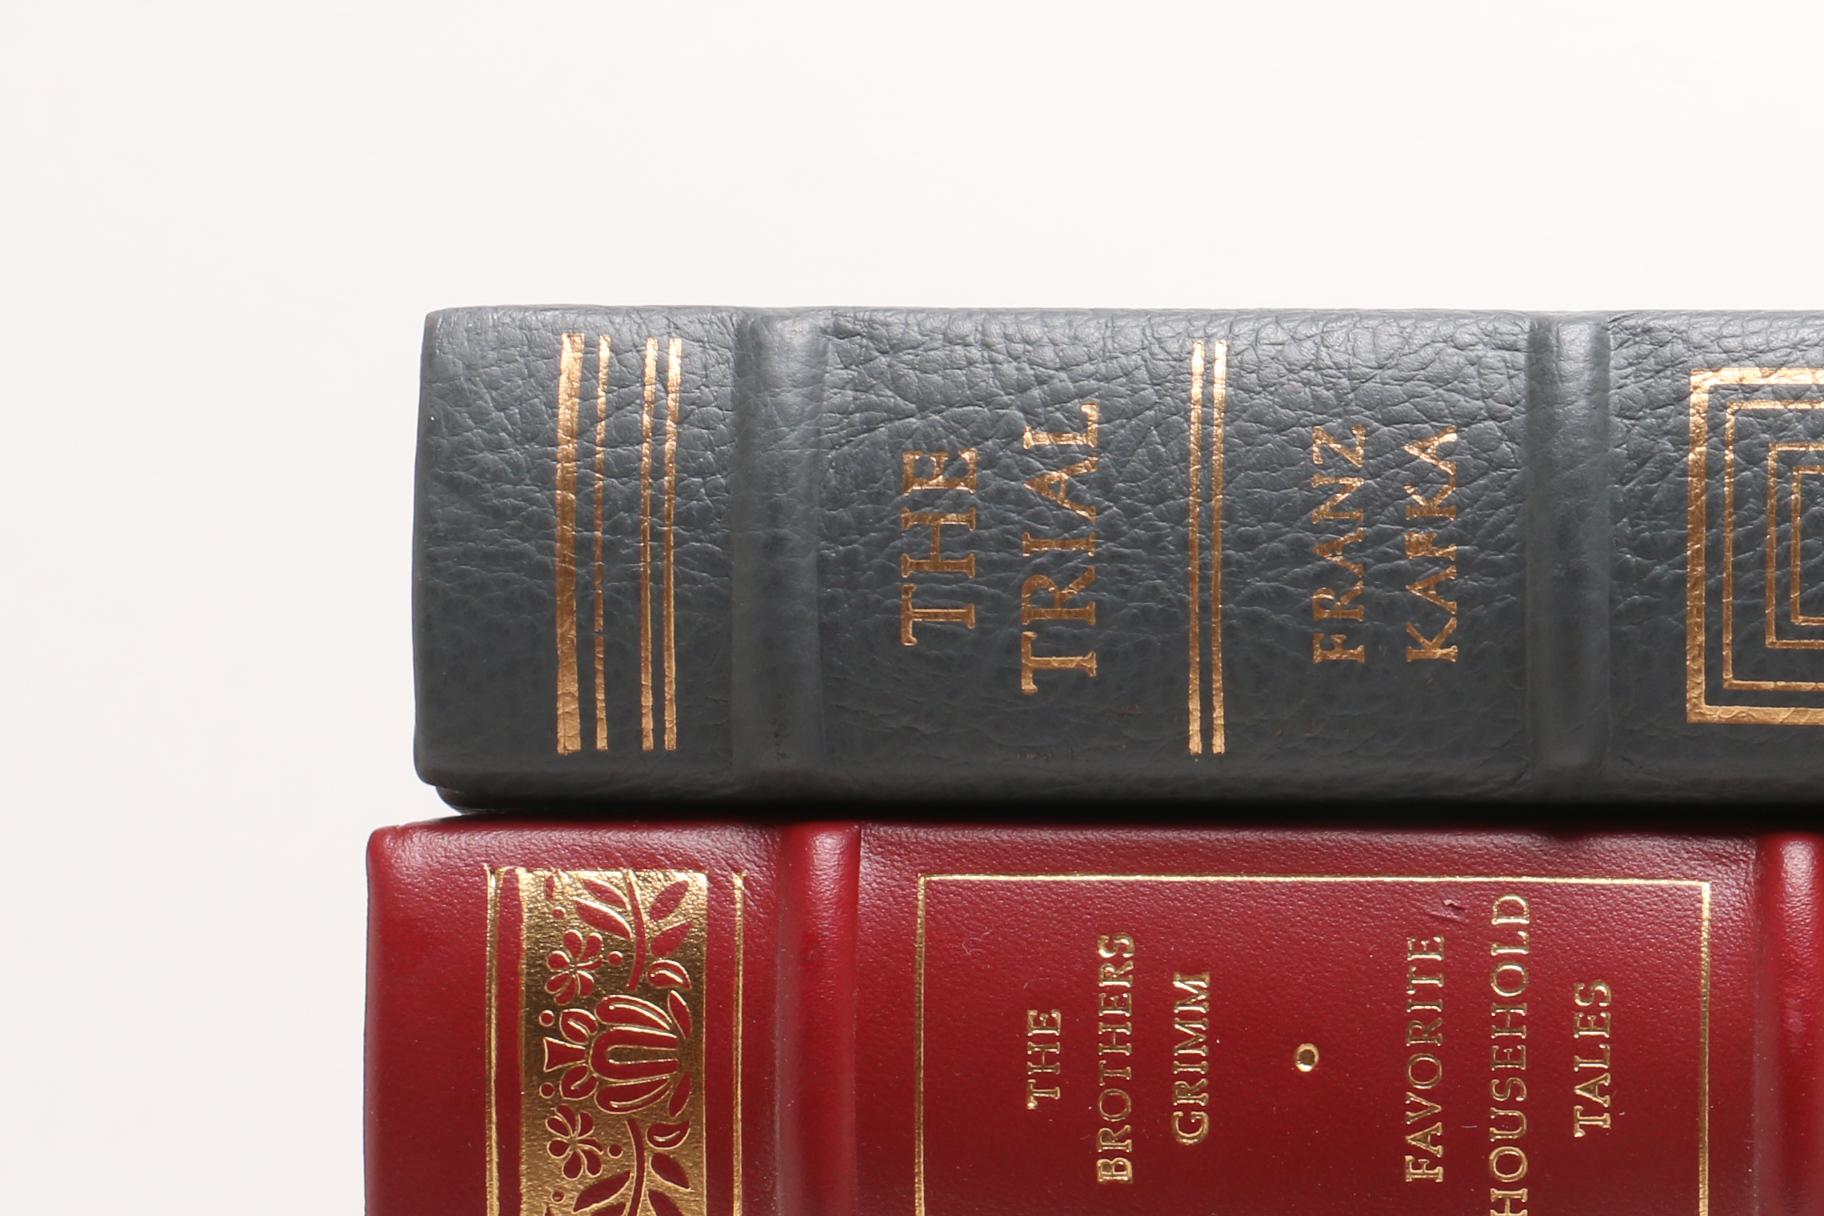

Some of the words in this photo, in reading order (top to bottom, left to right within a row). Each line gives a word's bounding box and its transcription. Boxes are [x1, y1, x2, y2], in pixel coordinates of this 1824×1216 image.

[900, 446, 977, 647] THE
[1020, 401, 1099, 694] TRIAL
[1312, 424, 1366, 664] FRANZ
[1405, 424, 1459, 664] KAFKA
[1026, 1008, 1062, 1110] THE
[1098, 931, 1136, 1186] BROTHERS
[1173, 971, 1211, 1145] GRIMM
[1405, 934, 1445, 1184] FAVORITE
[1573, 979, 1612, 1139] TALES
